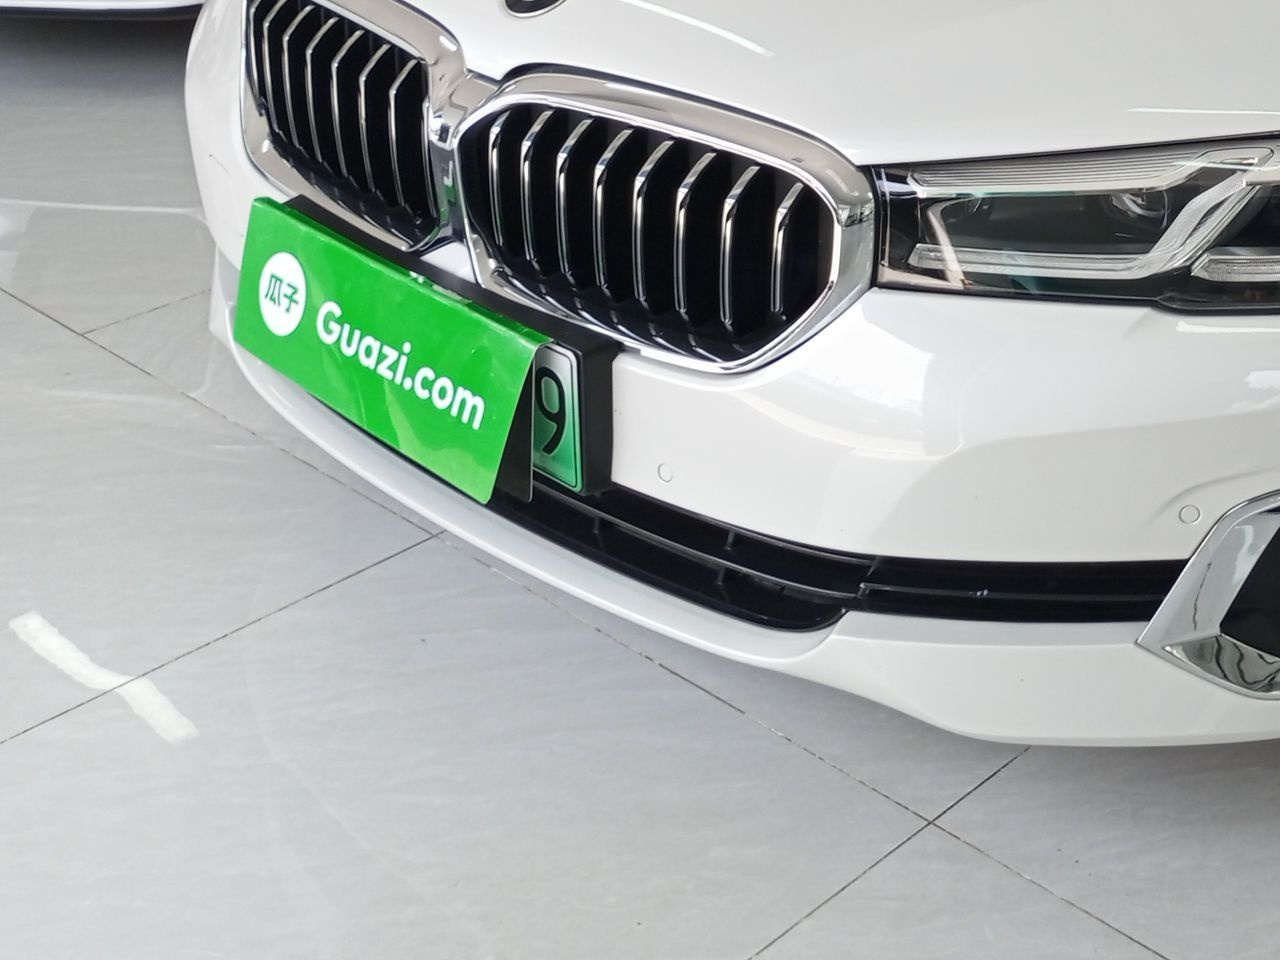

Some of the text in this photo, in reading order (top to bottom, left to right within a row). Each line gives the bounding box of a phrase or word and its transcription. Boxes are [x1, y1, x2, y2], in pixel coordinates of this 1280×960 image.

[264, 273, 299, 313] 瓜子
[316, 301, 486, 431] Guazi.com
[535, 366, 567, 456] 9
